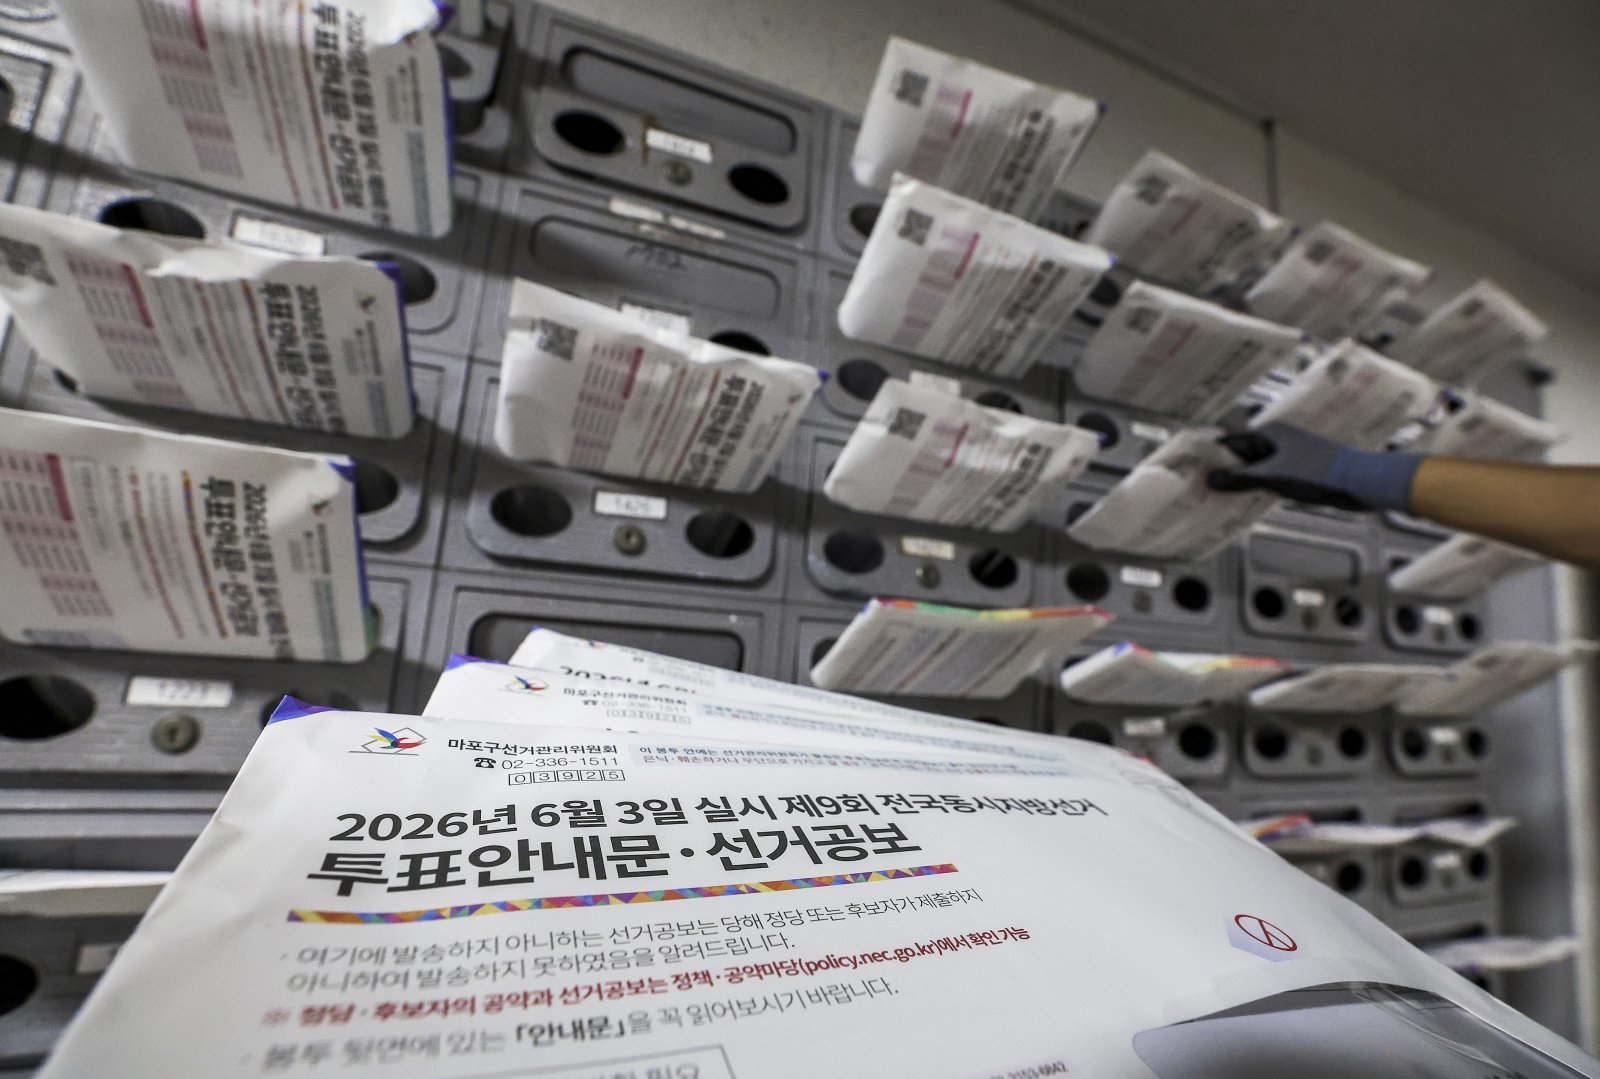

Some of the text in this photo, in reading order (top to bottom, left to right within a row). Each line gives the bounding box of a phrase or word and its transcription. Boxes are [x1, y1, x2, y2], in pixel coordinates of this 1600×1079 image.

[448, 738, 618, 756] 마포구선거관리위원회
[502, 757, 619, 769] 02-336-1511
[508, 769, 625, 785] 03925
[329, 793, 1109, 842] 2026년 6월 3일 실시 제9회 전국동시지방선거
[297, 888, 984, 967] 여기에 발송하지 아니하는 선거공보는 당해 정당 또는 후보자가 제출하지
[287, 931, 796, 994] 아니하여 발송하지 못하였음을 알려드립니다.
[483, 987, 554, 1015] 공약과
[558, 976, 668, 1002] 선거공보는
[968, 929, 1001, 948] 확인
[999, 925, 1031, 942] 가능
[805, 976, 899, 1007] 바랍니다.
